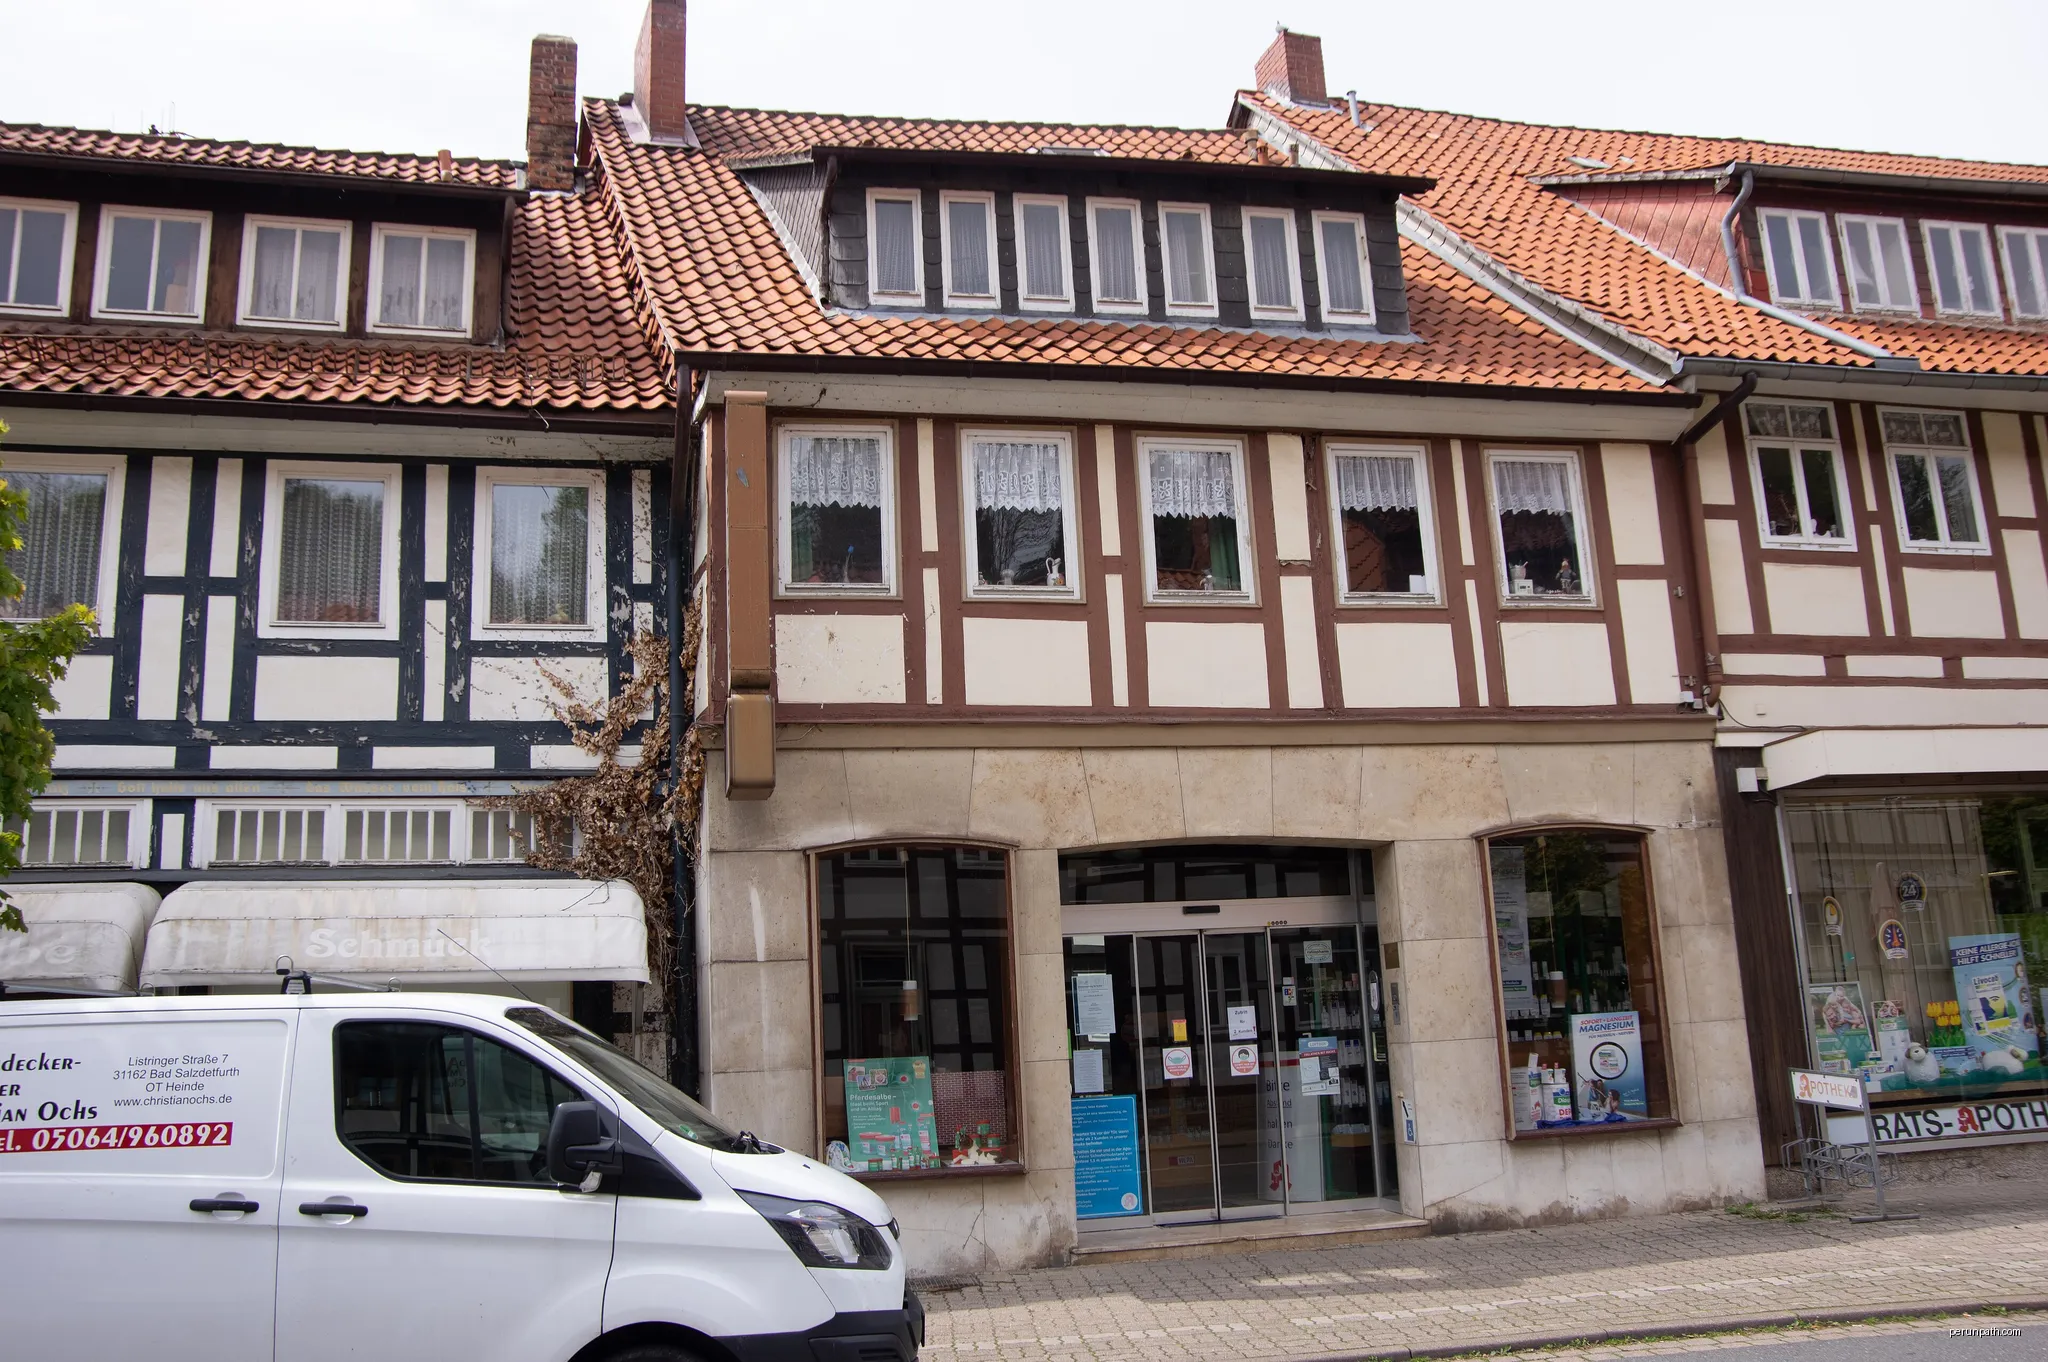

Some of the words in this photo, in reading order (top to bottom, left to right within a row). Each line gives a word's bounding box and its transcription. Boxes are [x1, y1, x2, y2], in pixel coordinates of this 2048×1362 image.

[1901, 884, 1917, 898] 24
[305, 927, 492, 959] Schmuck
[1955, 947, 1978, 957] KEINE
[1957, 956, 1979, 965] HILFT
[1973, 974, 1999, 985] Livocab
[1579, 1020, 1634, 1033] MAGNESIUM
[128, 1056, 179, 1067] Listringer
[181, 1054, 218, 1065] Straße
[222, 1054, 229, 1063] 7
[112, 1070, 147, 1080] 31162
[150, 1069, 172, 1079] Bad
[175, 1067, 240, 1078] Salzdetfurth
[145, 1082, 163, 1092] OT
[165, 1081, 205, 1092] Heinde
[1799, 1073, 1858, 1099] APOTHEK
[113, 1094, 233, 1107] www.christianochs.de
[1267, 1118, 1293, 1128] halen
[32, 1124, 228, 1150] 05064/960892
